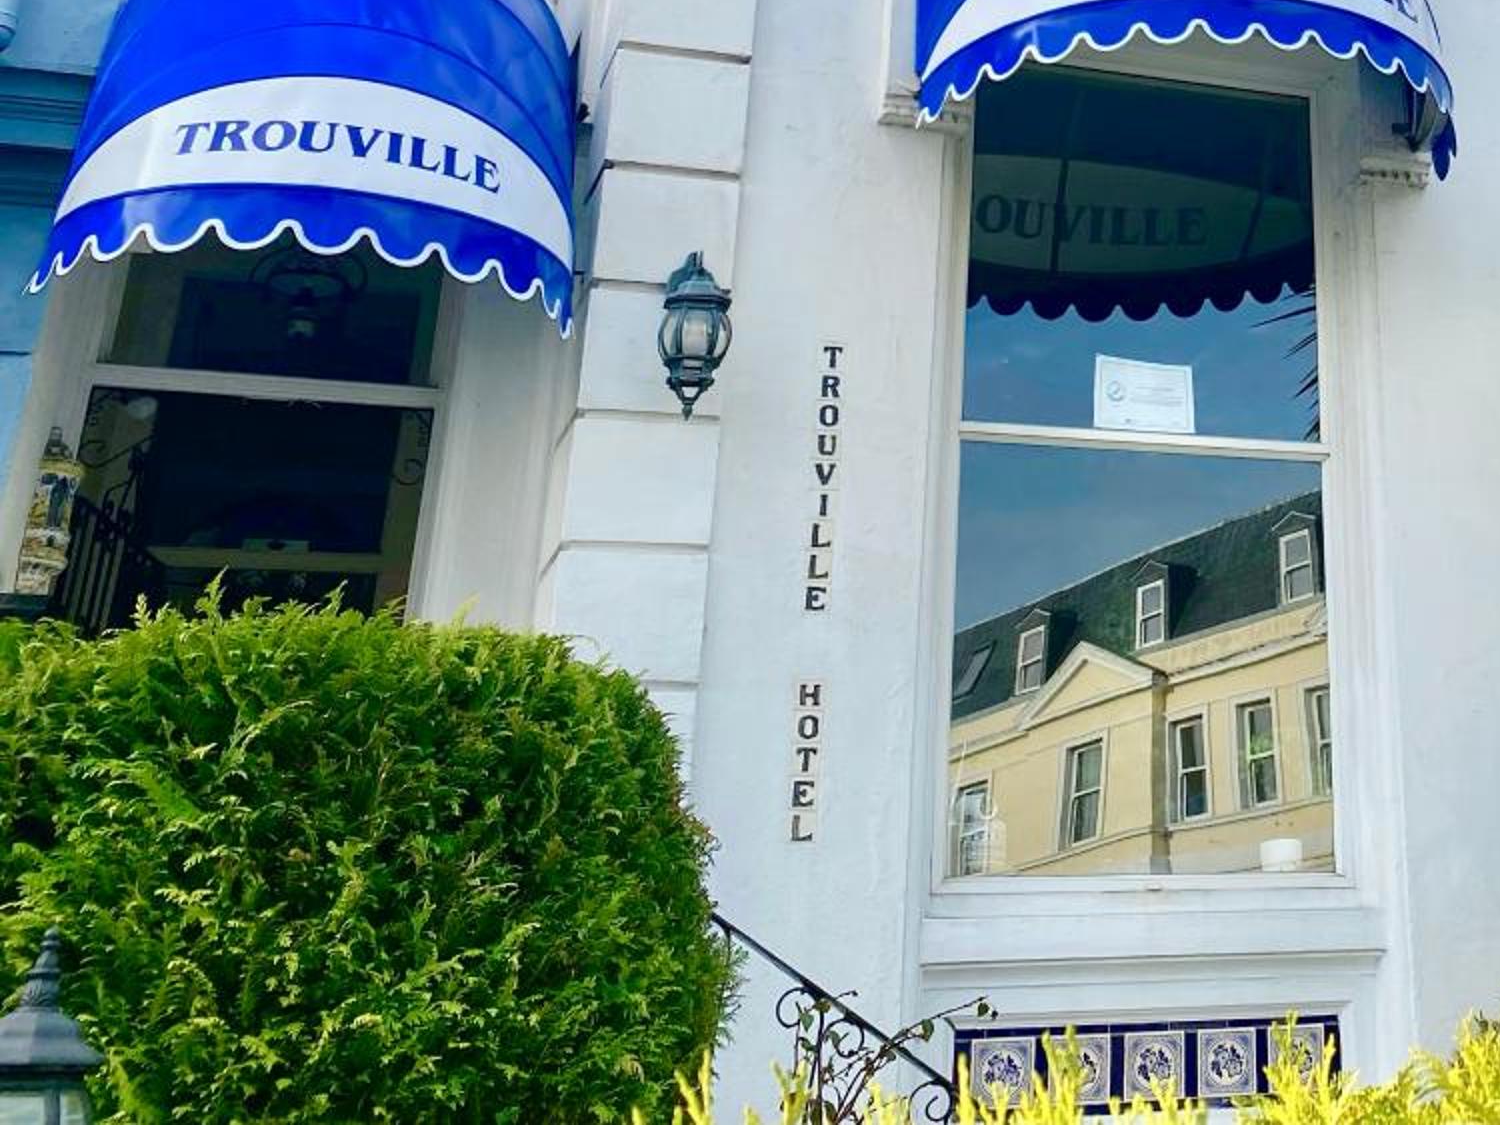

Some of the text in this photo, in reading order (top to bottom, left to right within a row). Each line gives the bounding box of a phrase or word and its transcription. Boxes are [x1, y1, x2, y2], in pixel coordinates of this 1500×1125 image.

[176, 119, 501, 194] TROUVILLE
[791, 346, 843, 842] TROUVILLE HOTEL
